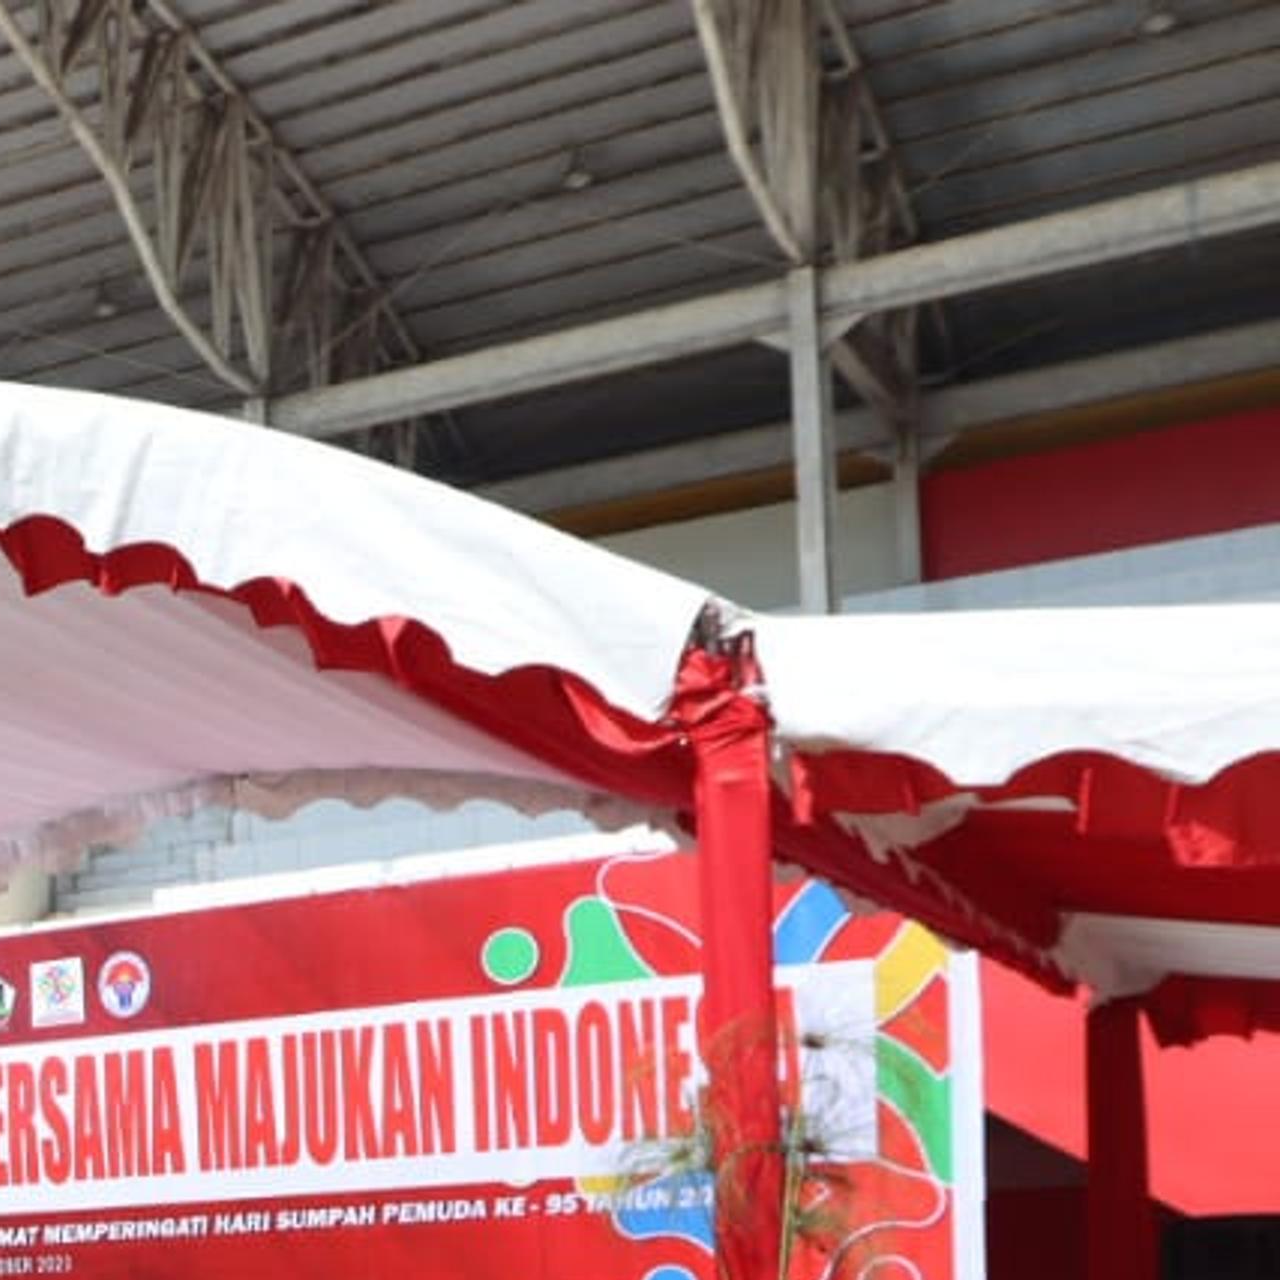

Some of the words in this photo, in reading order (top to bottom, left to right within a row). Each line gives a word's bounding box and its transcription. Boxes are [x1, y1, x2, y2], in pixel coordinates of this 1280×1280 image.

[194, 1018, 457, 1172] MAJUKAN
[42, 1215, 208, 1245] MEMPERINGATI
[213, 1210, 269, 1234] HARI
[275, 1204, 376, 1231] SUMPAH
[382, 1199, 487, 1225] PEMUDA
[494, 1195, 527, 1217] KE
[544, 1192, 579, 1214] 95
